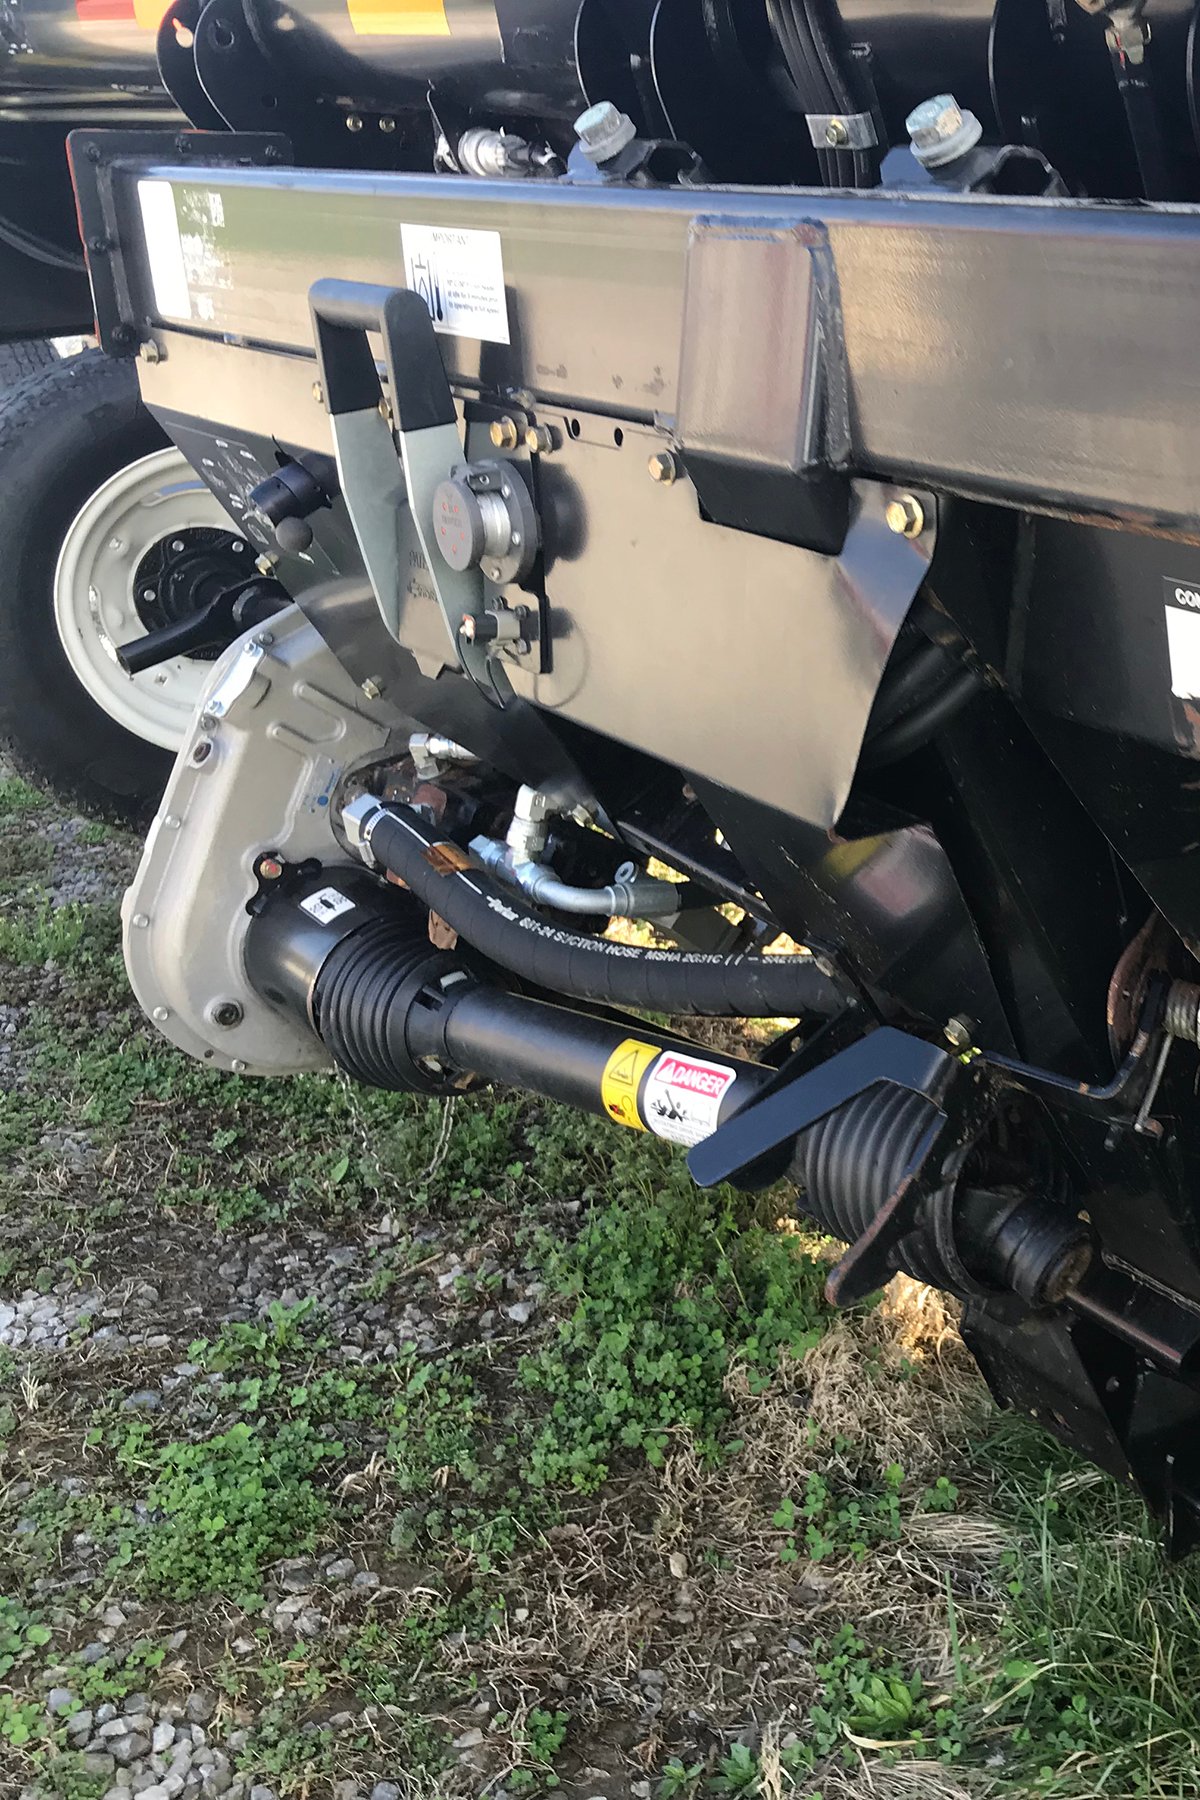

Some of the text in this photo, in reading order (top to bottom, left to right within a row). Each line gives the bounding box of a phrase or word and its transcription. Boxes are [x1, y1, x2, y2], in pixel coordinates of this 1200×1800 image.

[553, 931, 608, 952] SUCTION
[606, 944, 643, 959] HOSE
[644, 950, 681, 963] MSHA
[674, 1066, 727, 1096] DANGER
